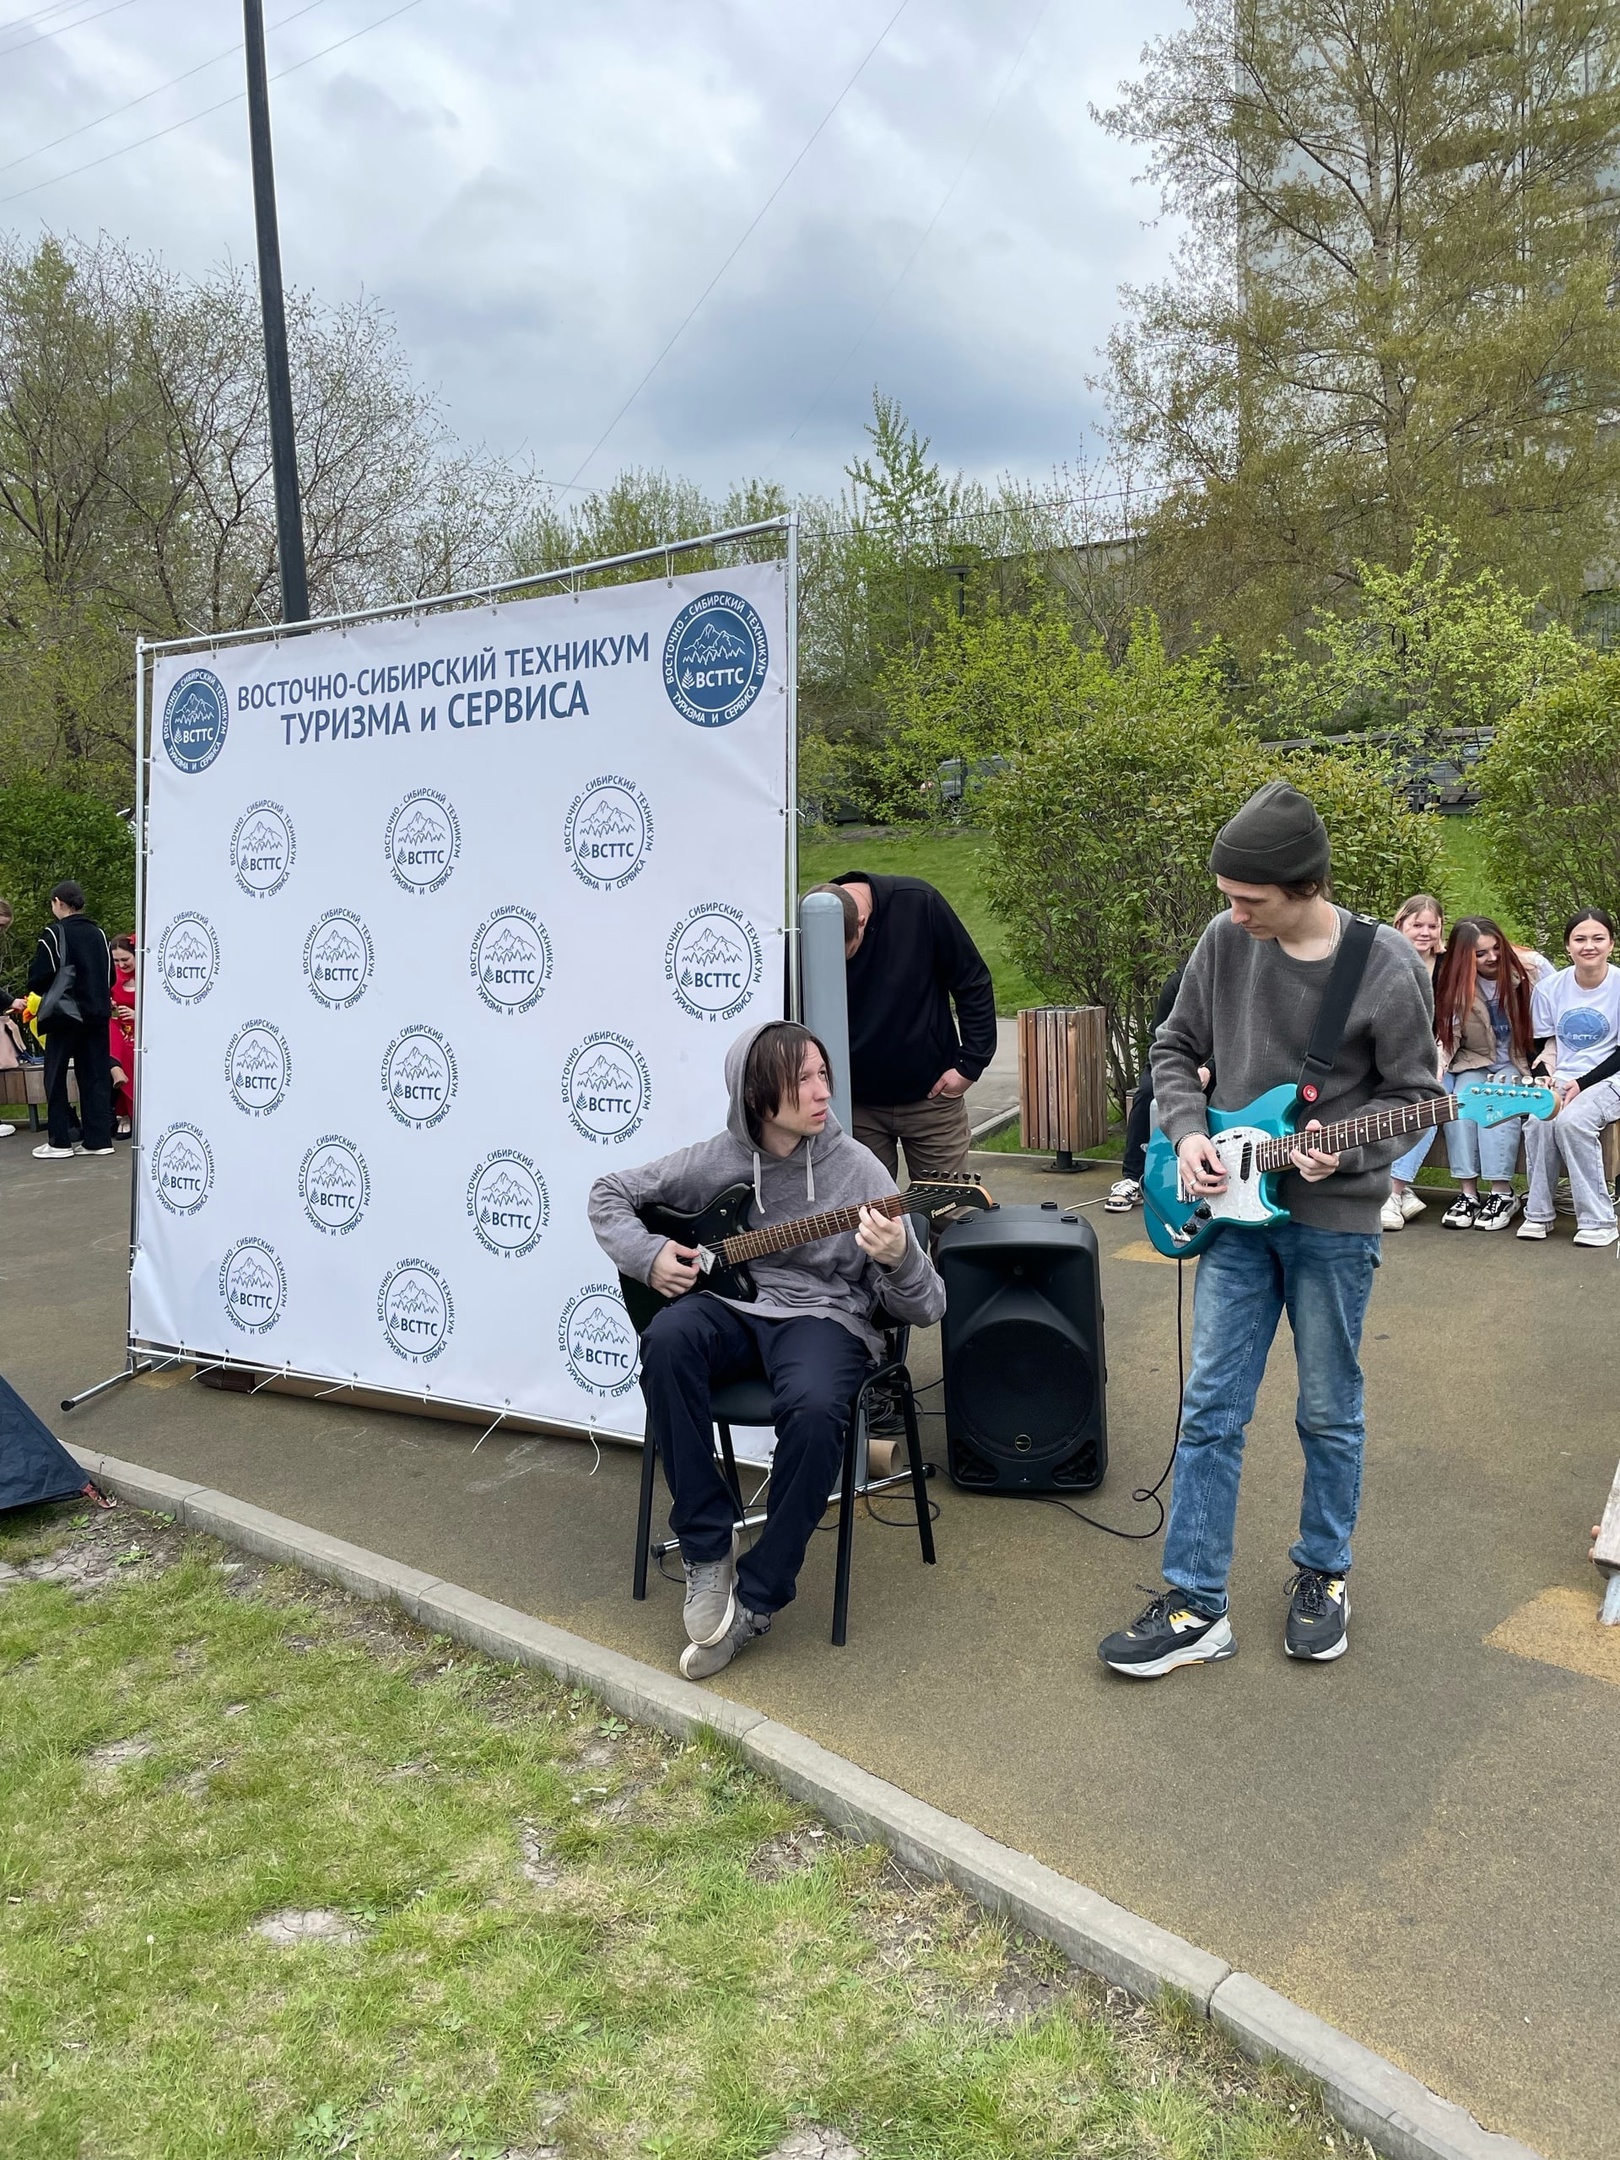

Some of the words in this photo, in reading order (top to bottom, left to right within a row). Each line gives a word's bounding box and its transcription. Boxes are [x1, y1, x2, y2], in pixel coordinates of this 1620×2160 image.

[664, 620, 685, 684] ВОСТОЧНО
[689, 595, 746, 616] СИБИРСКИЙ
[746, 610, 768, 676] ТЕХНИКУМ
[239, 647, 496, 712] ВОСТОЧНО-СИБИРСКИЙ
[505, 632, 649, 678] ТЕХНИКУМ
[696, 667, 744, 689] ВСТТС
[163, 690, 177, 739] ВОСТОЧНО
[180, 671, 216, 689] СИБИРСКИЙ
[215, 683, 229, 735] ТЕХНИКУМ
[281, 701, 410, 746] ТУРИЗМА
[421, 706, 436, 732] и
[449, 680, 590, 729] СЕРВИСА
[672, 691, 706, 723] ТУРИЗМА
[724, 685, 758, 720] СЕРВИСА
[183, 727, 214, 744] ВСТТС
[168, 745, 189, 771] ТУРИЗМА
[199, 741, 222, 768] СЕРВИСА
[385, 807, 399, 859] ВОСТОЧНО
[403, 788, 446, 804] СИБИРСКИЙ
[447, 803, 461, 858] ТЕХНИКУМ
[564, 795, 581, 852] ВОСТОЧНО
[586, 775, 636, 793] СИБИРСКИЙ
[637, 792, 654, 851] ТЕХНИКУМ
[230, 817, 243, 866] ВОСТОЧНО
[247, 800, 284, 815] СИБИРСКИЙ
[285, 814, 296, 864] ТЕХНИКУМ
[250, 857, 281, 871] ВСТТС
[408, 850, 444, 865] ВСТТС
[592, 842, 634, 858] ВСТТС
[235, 872, 255, 898] ТУРИЗМА
[268, 872, 290, 896] СЕРВИСА
[390, 866, 414, 894] ТУРИЗМА
[429, 866, 454, 892] СЕРВИСА
[571, 860, 599, 890] ТУРИЗМА
[617, 860, 645, 888] СЕРВИСА
[158, 926, 170, 972] ВОСТОЧНО
[174, 911, 208, 926] СИБИРСКИЙ
[209, 926, 220, 974] ТЕХНИКУМ
[303, 925, 317, 974] ВОСТОЧНО
[321, 908, 360, 924] СИБИРСКИЙ
[362, 924, 374, 976] ТЕХНИКУМ
[470, 923, 486, 976] ВОСТОЧНО
[490, 905, 536, 923] СИБИРСКИЙ
[538, 922, 553, 979] ТЕХНИКУМ
[665, 922, 684, 980] ВОСТОЧНО
[689, 902, 743, 921] СИБИРСКИЙ
[745, 921, 762, 982] ТЕХНИКУМ
[177, 967, 206, 979] ВСТТС
[325, 968, 358, 981] ВСТТС
[496, 970, 534, 984] ВСТТС
[695, 972, 741, 988] ВСТТС
[162, 979, 181, 1005] ТУРИЗМА
[194, 981, 214, 1004] СЕРВИСА
[308, 982, 330, 1009] ТУРИЗМА
[344, 984, 367, 1008] СЕРВИСА
[476, 984, 502, 1014] ТУРИЗМА
[518, 987, 545, 1013] СЕРВИСА
[672, 988, 702, 1020] ТУРИЗМА
[722, 991, 753, 1020] СЕРВИСА
[225, 1034, 238, 1081] ВОСТОЧНО
[242, 1019, 279, 1035] СИБИРСКИЙ
[280, 1035, 292, 1086] ТЕХНИКУМ
[381, 1040, 396, 1091] ВОСТОЧНО
[400, 1024, 443, 1042] СИБИРСКИЙ
[444, 1042, 458, 1097] ТЕХНИКУМ
[245, 1076, 277, 1090] ВСТТС
[562, 1048, 579, 1103] ВОСТОЧНО
[584, 1031, 633, 1051] СИБИРСКИЙ
[635, 1051, 651, 1110] ТЕХНИКУМ
[229, 1088, 250, 1115] ТУРИЗМА
[263, 1093, 285, 1116] СЕРВИСА
[405, 1085, 441, 1101] ВСТТС
[589, 1097, 631, 1114] ВСТТС
[387, 1099, 411, 1128] ТУРИЗМА
[426, 1104, 451, 1128] СЕРВИСА
[568, 1111, 596, 1143] ТУРИЗМА
[614, 1117, 643, 1144] СЕРВИСА
[152, 1135, 164, 1180] ВОСТОЧНО
[168, 1122, 203, 1139] СИБИРСКИЙ
[204, 1139, 215, 1188] ТЕХНИКУМ
[171, 1176, 200, 1191] ВСТТС
[299, 1148, 313, 1197] ВОСТОЧНО
[316, 1135, 356, 1153] СИБИРСКИЙ
[358, 1153, 371, 1206] ТЕХНИКУМ
[156, 1187, 175, 1215] ТУРИЗМА
[188, 1194, 208, 1216] СЕРВИСА
[321, 1193, 354, 1209] ВСТТС
[467, 1164, 483, 1216] ВОСТОЧНО
[487, 1149, 533, 1169] СИБИРСКИЙ
[535, 1169, 550, 1226] ТЕХНИКУМ
[304, 1205, 326, 1234] ТУРИЗМА
[340, 1212, 364, 1235] СЕРВИСА
[492, 1212, 531, 1229] ВСТТС
[473, 1224, 499, 1256] ТУРИЗМА
[515, 1233, 542, 1258] СЕРВИСА
[219, 1249, 233, 1296] ВОСТОЧНО
[236, 1237, 274, 1255] СИБИРСКИЙ
[275, 1256, 287, 1307] ТЕХНИКУМ
[240, 1293, 272, 1309] ВСТТС
[377, 1271, 392, 1321] ВОСТОЧНО
[397, 1258, 439, 1278] СИБИРСКИЙ
[441, 1279, 455, 1334] ТЕХНИКУМ
[224, 1303, 245, 1332] ТУРИЗМА
[259, 1313, 281, 1334] СЕРВИСА
[401, 1318, 437, 1336] ВСТТС
[558, 1297, 576, 1351] ВОСТОЧНО
[580, 1283, 625, 1302] СИБИРСКИ
[383, 1329, 407, 1361] ТУРИЗМА
[422, 1340, 447, 1363] СЕРВИСА
[586, 1348, 628, 1369] ВСТТС
[565, 1360, 593, 1394] ТУРИЗМА
[611, 1373, 640, 1397] СЕРВИСА
